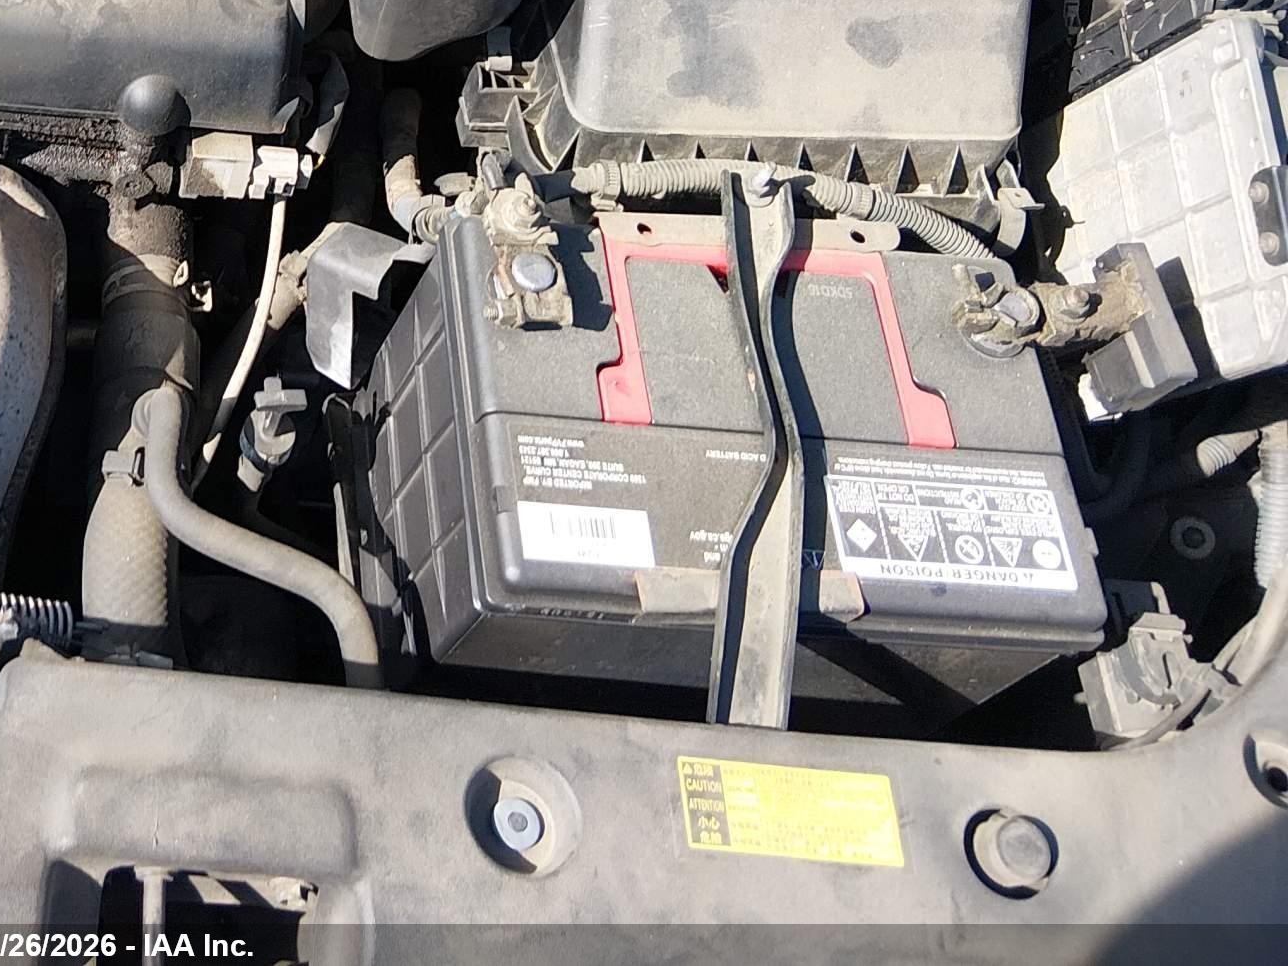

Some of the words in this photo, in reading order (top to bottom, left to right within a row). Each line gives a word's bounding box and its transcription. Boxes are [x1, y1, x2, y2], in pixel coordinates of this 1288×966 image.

[705, 449, 739, 460] BATTERY
[740, 451, 759, 462] ACID
[552, 466, 583, 479] CENTER
[583, 469, 629, 483] CORPORATE
[880, 563, 945, 578] POISON
[951, 567, 1020, 583] DANGER
[685, 779, 722, 794] CAUTION
[688, 797, 725, 812] ATTENTION
